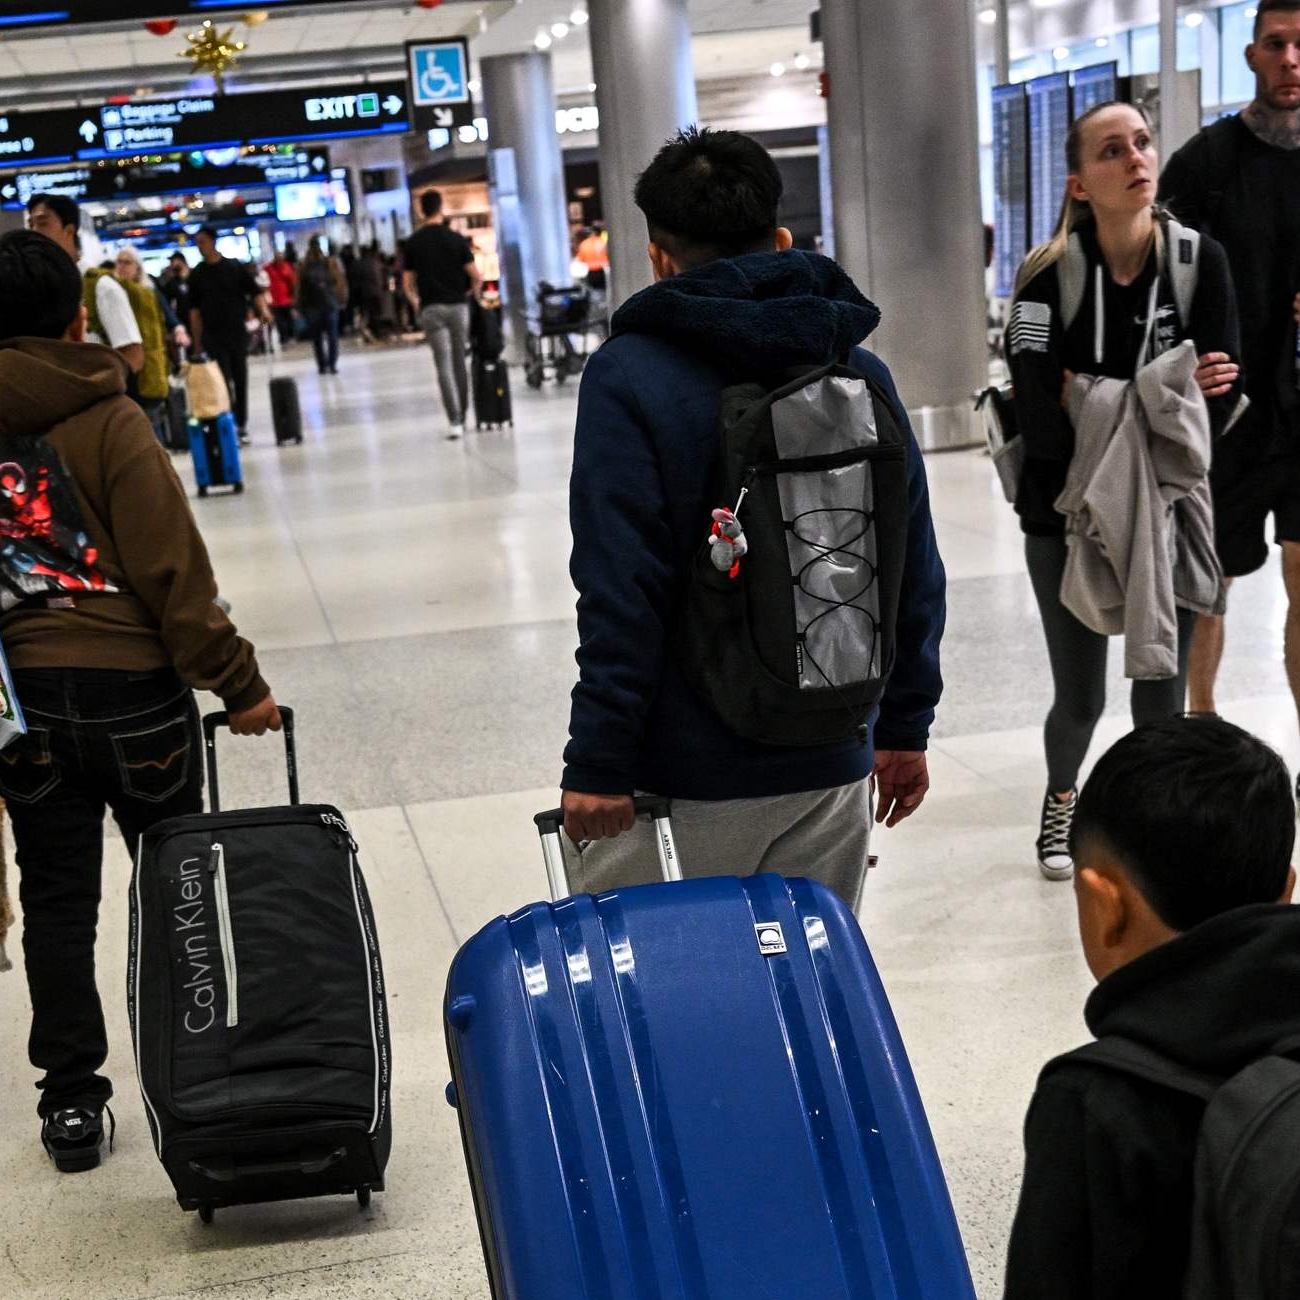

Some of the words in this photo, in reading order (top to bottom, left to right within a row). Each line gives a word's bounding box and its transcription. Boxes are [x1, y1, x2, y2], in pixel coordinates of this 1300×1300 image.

[305, 96, 358, 121] EXIT
[170, 857, 206, 932] Klein
[177, 935, 215, 1033] Calvin
